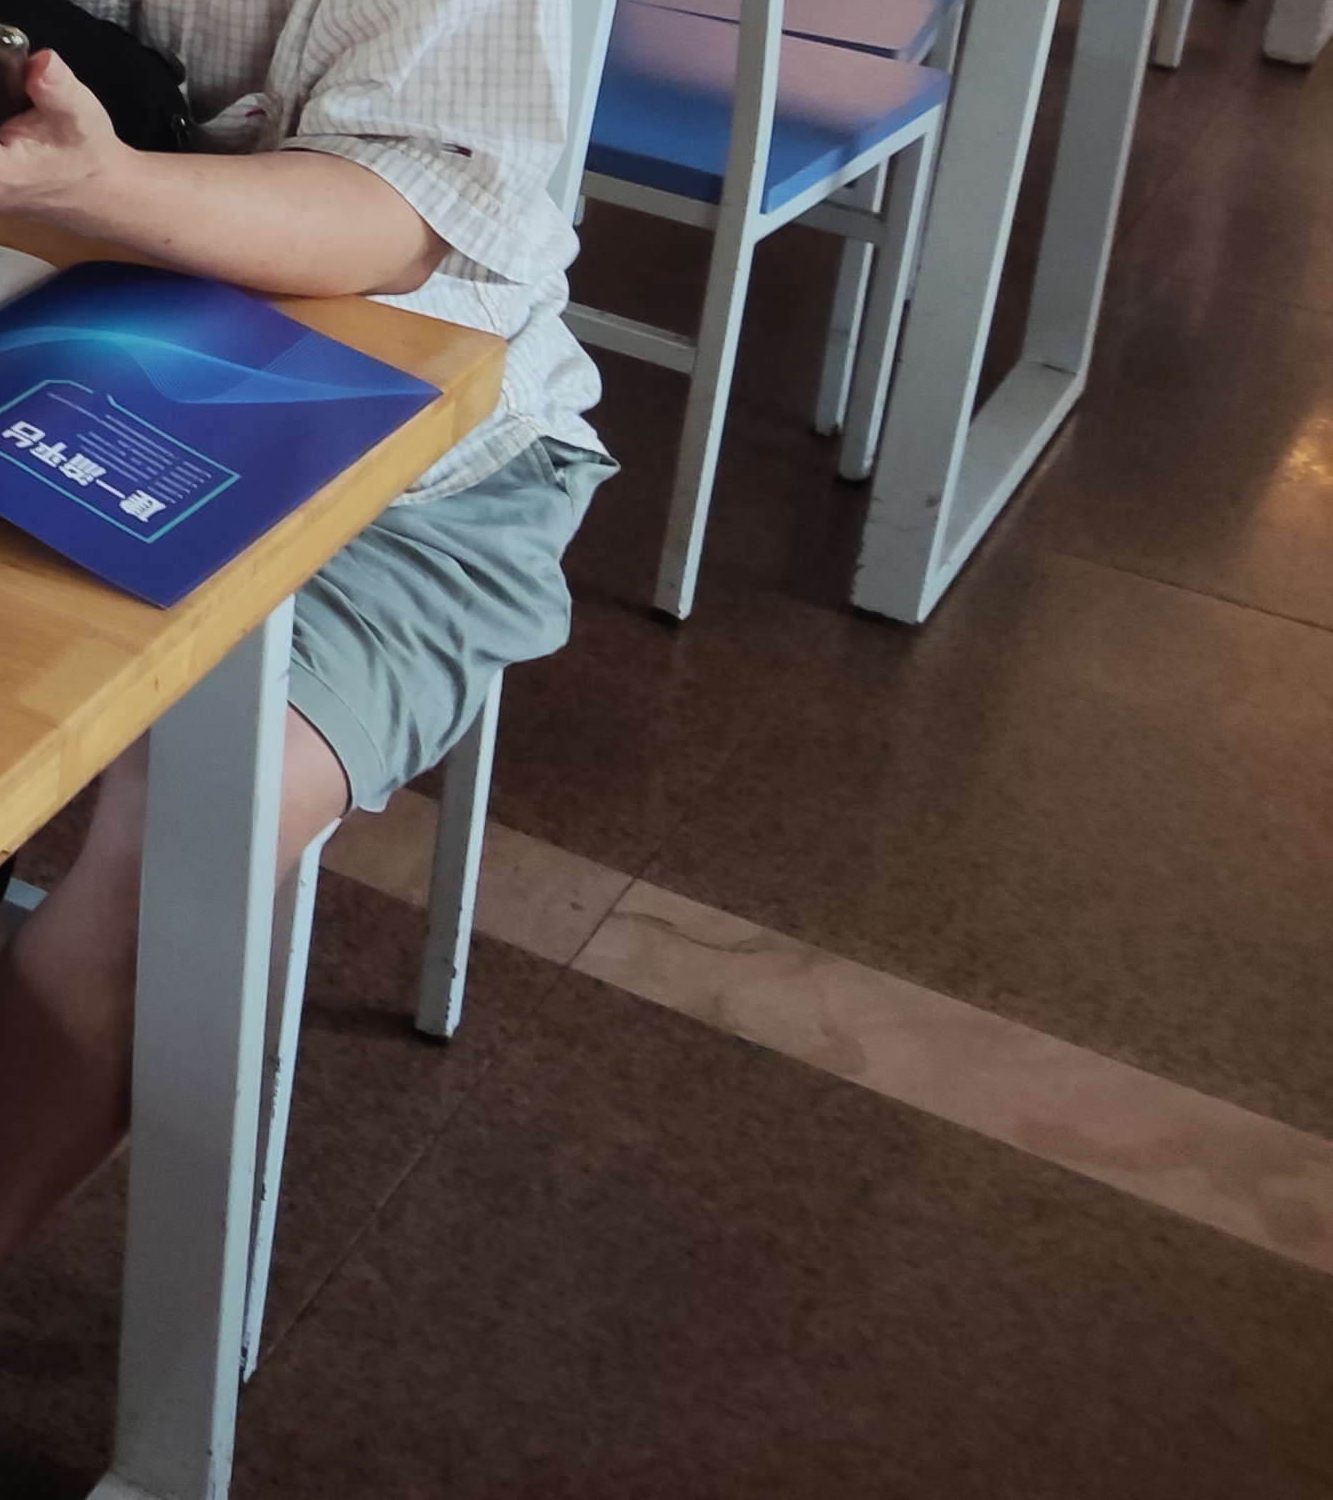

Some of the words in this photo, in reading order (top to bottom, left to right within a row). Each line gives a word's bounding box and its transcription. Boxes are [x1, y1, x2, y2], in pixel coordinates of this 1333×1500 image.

[2, 419, 167, 523] 建一流平台
